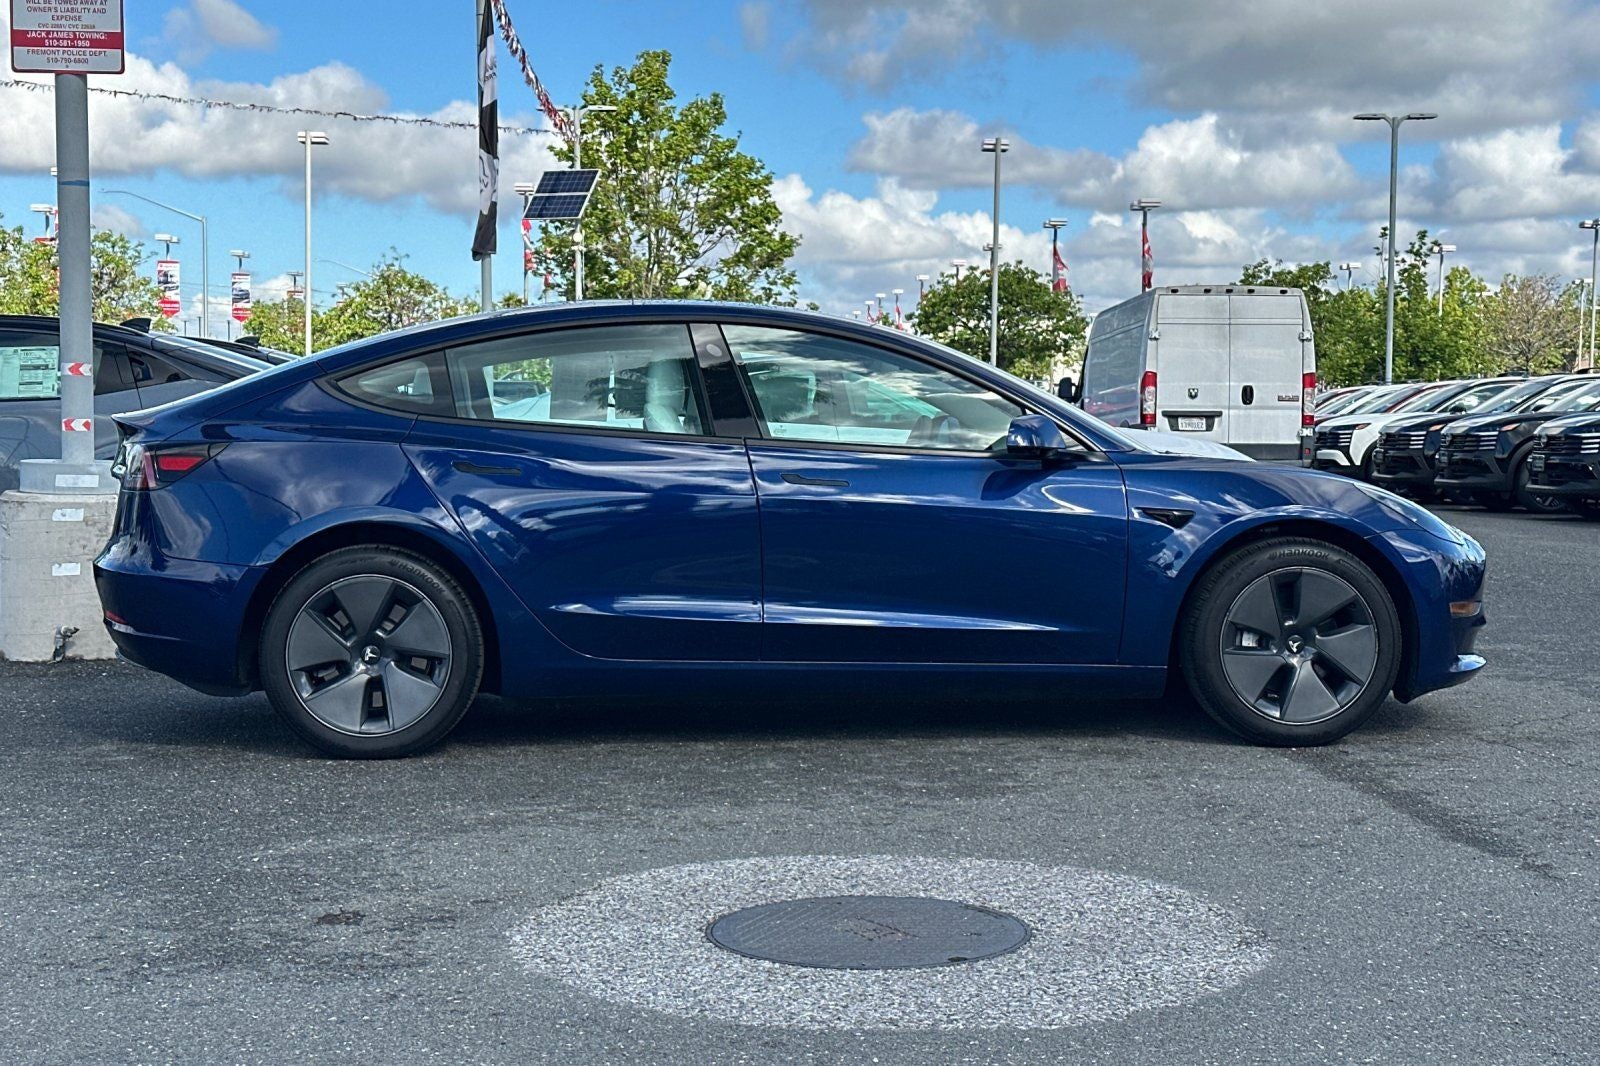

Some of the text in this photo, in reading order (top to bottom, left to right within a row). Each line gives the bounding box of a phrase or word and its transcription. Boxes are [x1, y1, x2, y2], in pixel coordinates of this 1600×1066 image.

[48, 31, 74, 39] JAMES
[75, 32, 108, 40] TOWING:
[44, 39, 90, 47] 510-581-1950
